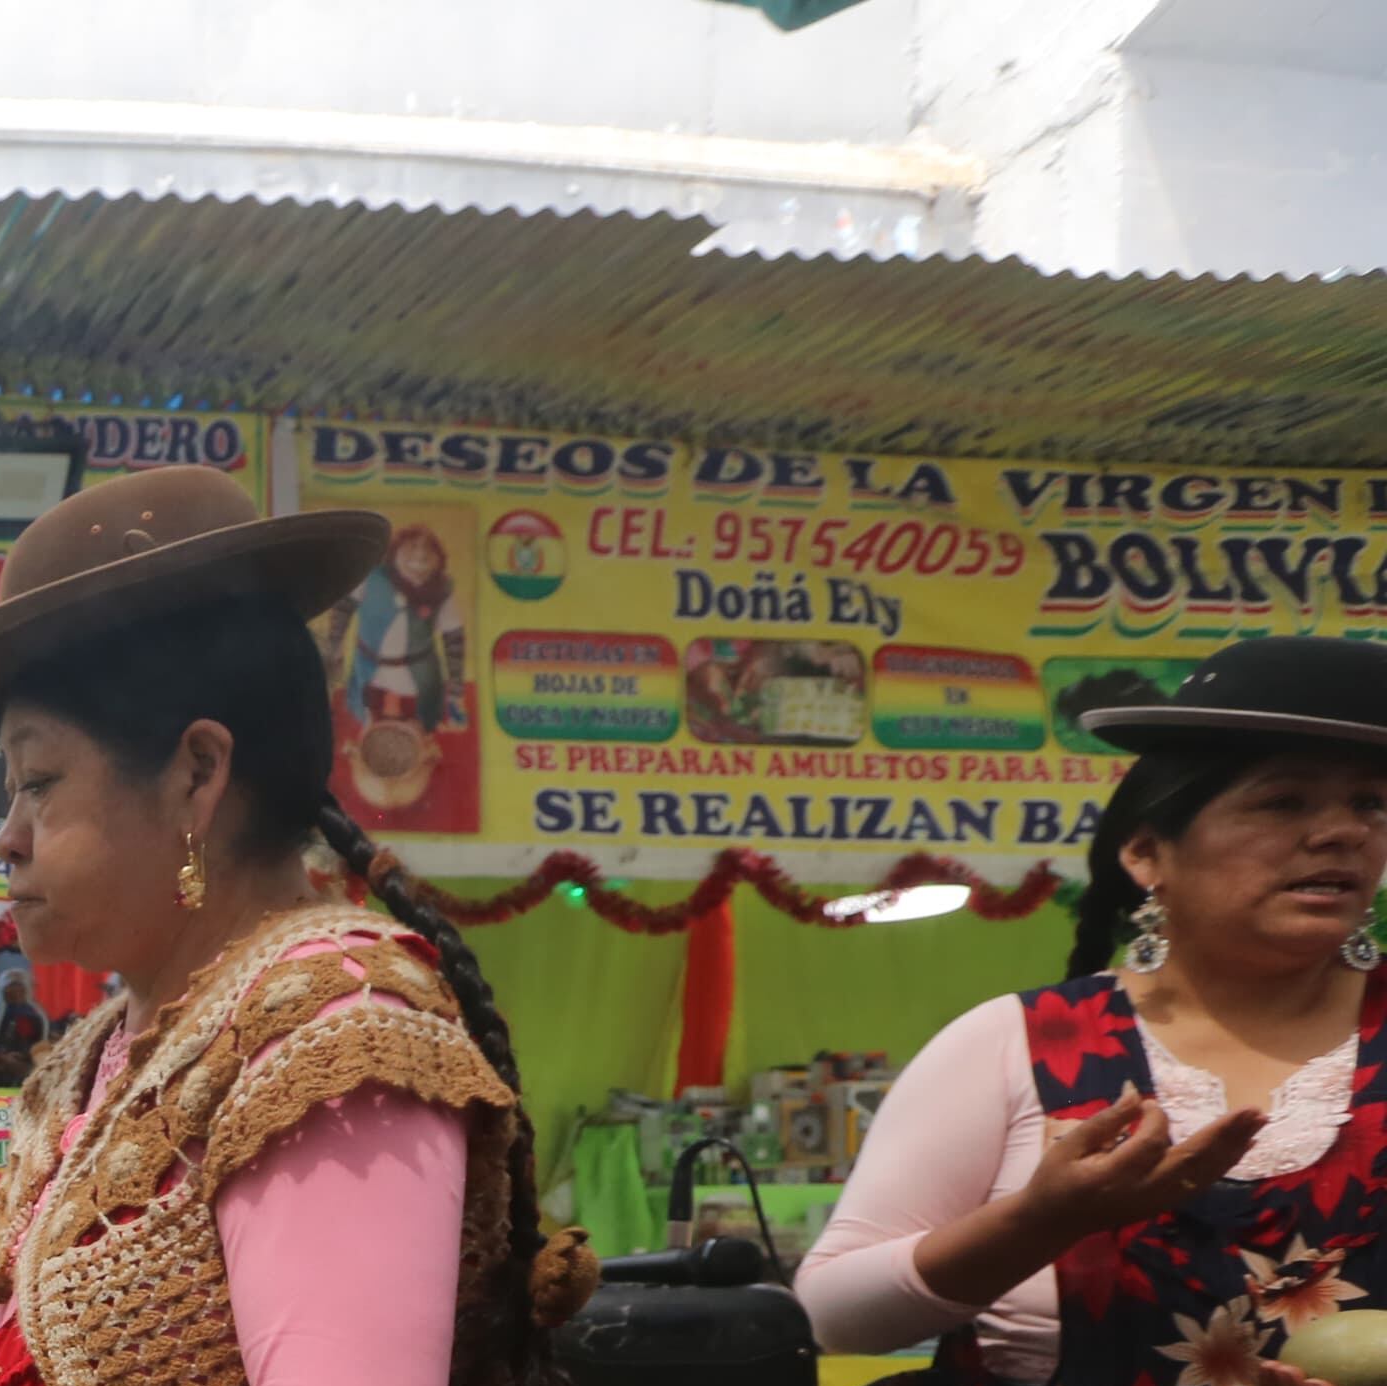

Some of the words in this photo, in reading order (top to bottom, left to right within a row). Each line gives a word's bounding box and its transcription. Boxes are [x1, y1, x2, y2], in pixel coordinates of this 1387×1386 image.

[313, 426, 674, 482] DESEOS
[694, 447, 824, 488] DE
[846, 459, 955, 503] LA
[1002, 468, 1341, 512] VIRGEN
[825, 575, 902, 637] Ely
[515, 745, 559, 771] SE
[566, 746, 756, 778] PREPARAN
[765, 752, 950, 782] AMULETOS
[958, 755, 1052, 783] PARA
[1060, 757, 1099, 783] EL
[534, 787, 623, 836] SE
[639, 791, 1002, 842] REALIZAN
